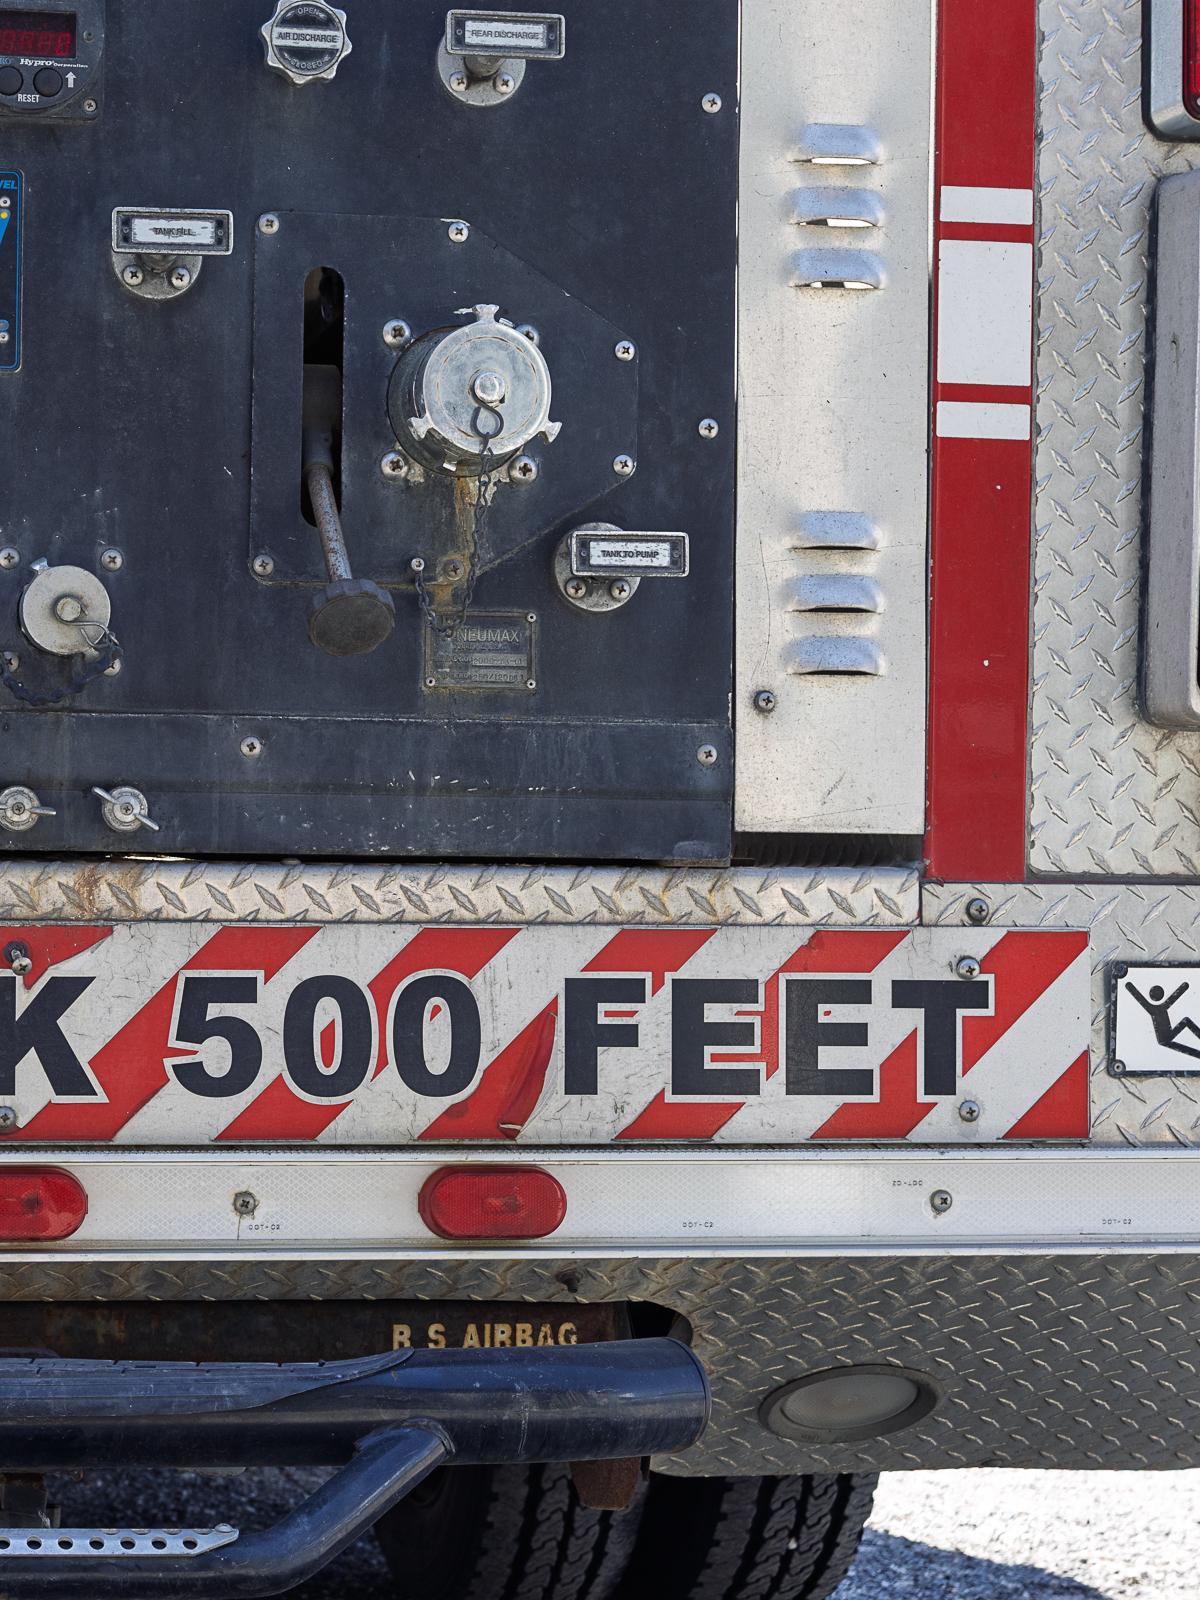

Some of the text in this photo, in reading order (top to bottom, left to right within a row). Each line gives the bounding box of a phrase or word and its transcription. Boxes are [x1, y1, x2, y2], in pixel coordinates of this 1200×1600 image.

[297, 7, 319, 15] OPEN
[278, 32, 337, 43] AIR DISCHARGE
[471, 30, 539, 40] REAR DISCHARGE
[19, 58, 53, 67] Hypro
[290, 59, 323, 70] CLOSED
[17, 94, 39, 103] RESET
[153, 227, 193, 236] TANK FILL
[601, 550, 659, 559] TANK TO PUMP
[167, 974, 482, 1099] 500
[564, 977, 990, 1098] FEET
[393, 1322, 578, 1350] R S AIRBAG
